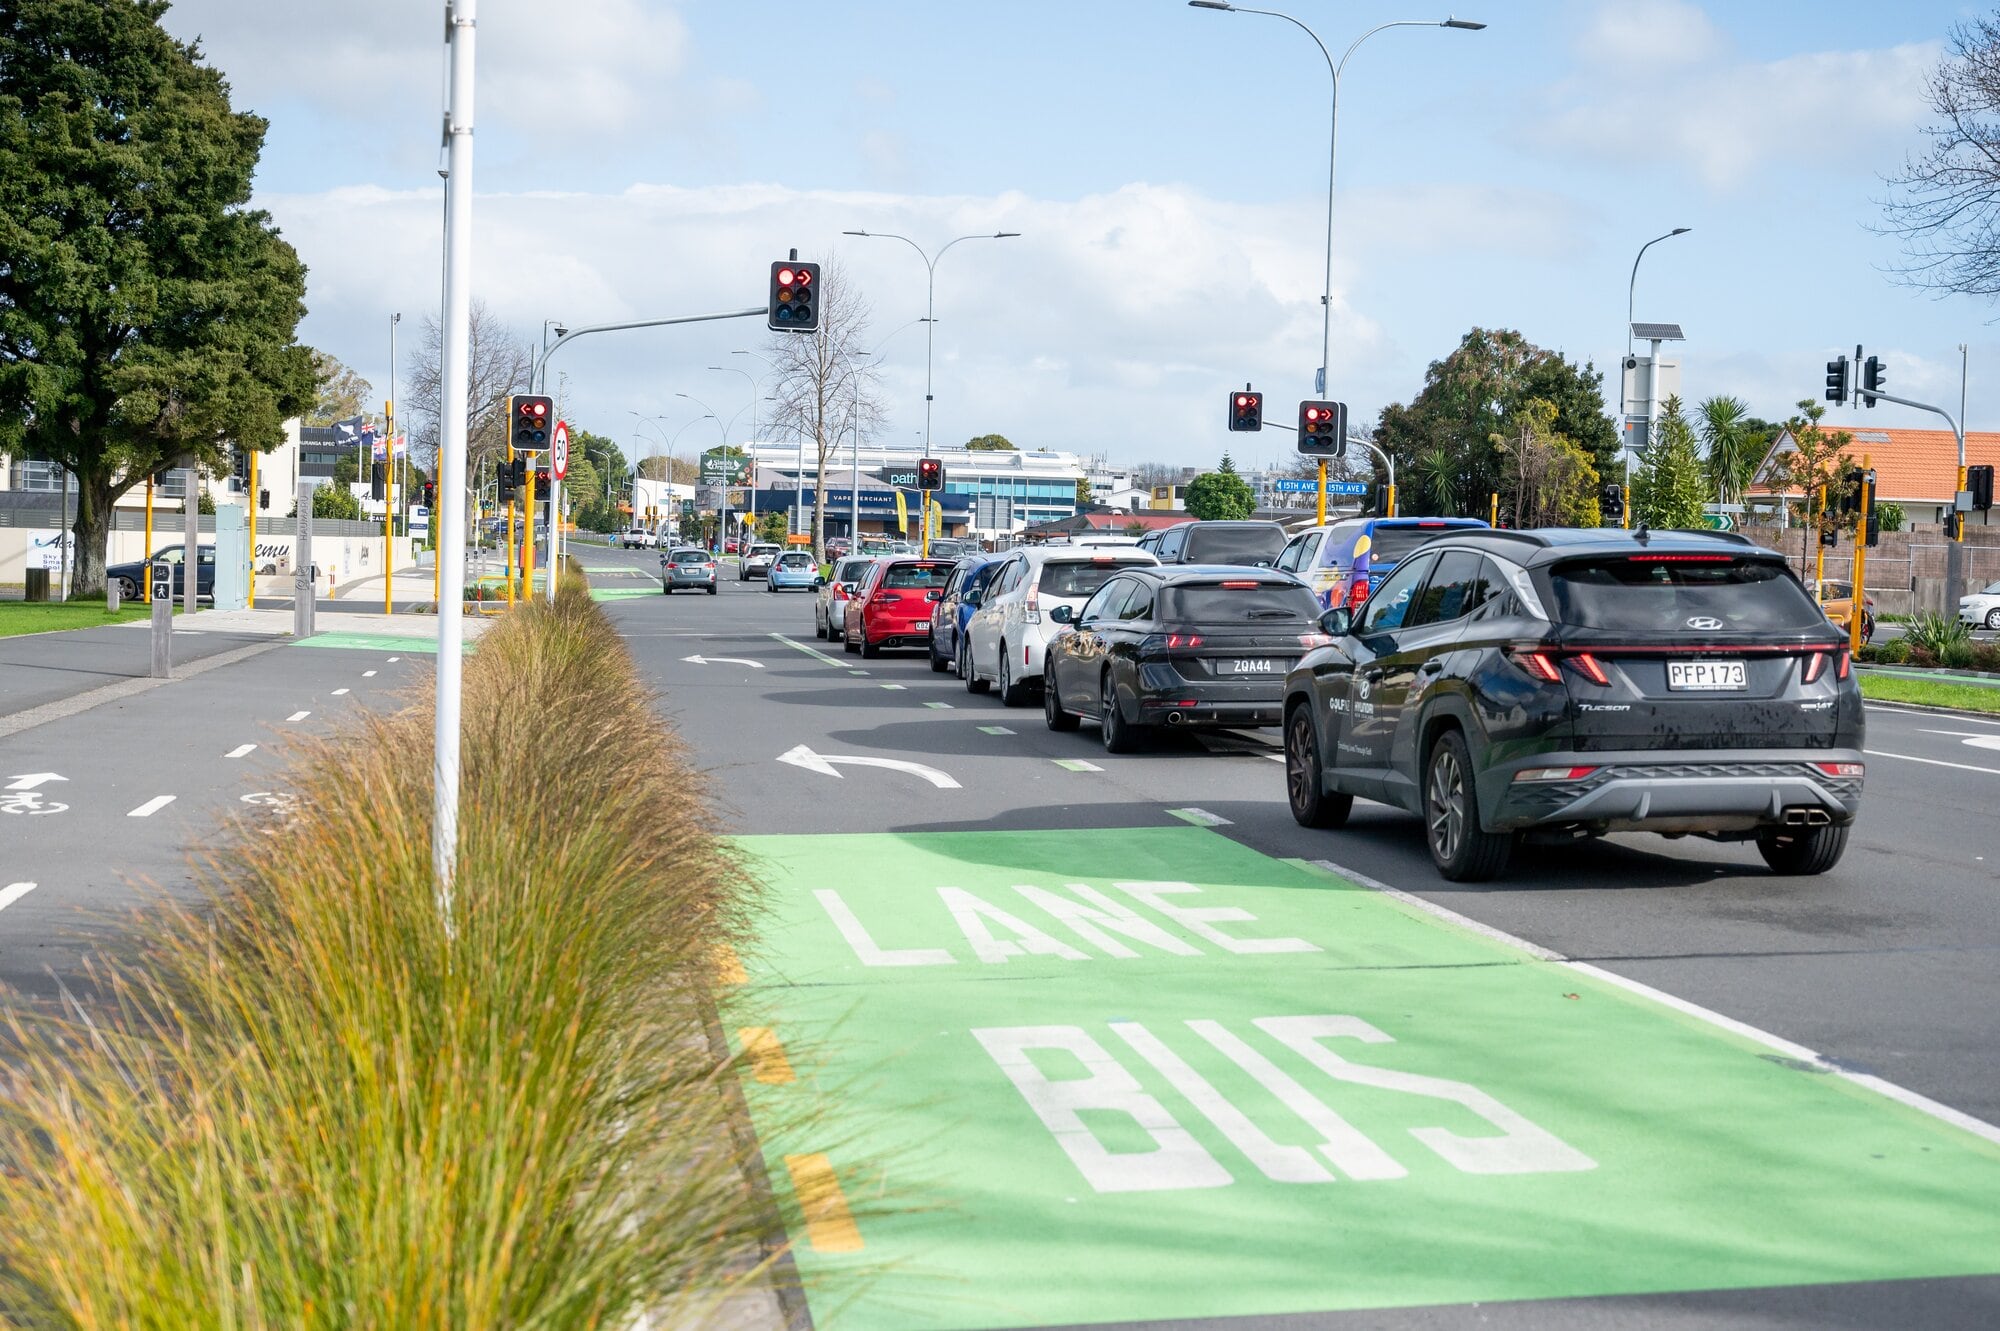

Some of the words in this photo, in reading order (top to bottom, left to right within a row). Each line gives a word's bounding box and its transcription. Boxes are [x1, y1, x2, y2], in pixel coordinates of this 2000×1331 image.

[556, 439, 566, 461] 50
[891, 474, 918, 485] path
[1283, 482, 1299, 490] 15TH
[1301, 482, 1316, 490] AVE
[1328, 484, 1344, 492] 15TH
[1346, 484, 1360, 493] AVE
[299, 496, 308, 541] HAUMARU
[1234, 660, 1271, 672] ZQA44
[1671, 665, 1744, 684] PFP173
[1578, 703, 1631, 711] Tucson
[812, 879, 1324, 967] LANE
[970, 1013, 1599, 1193] BUS
